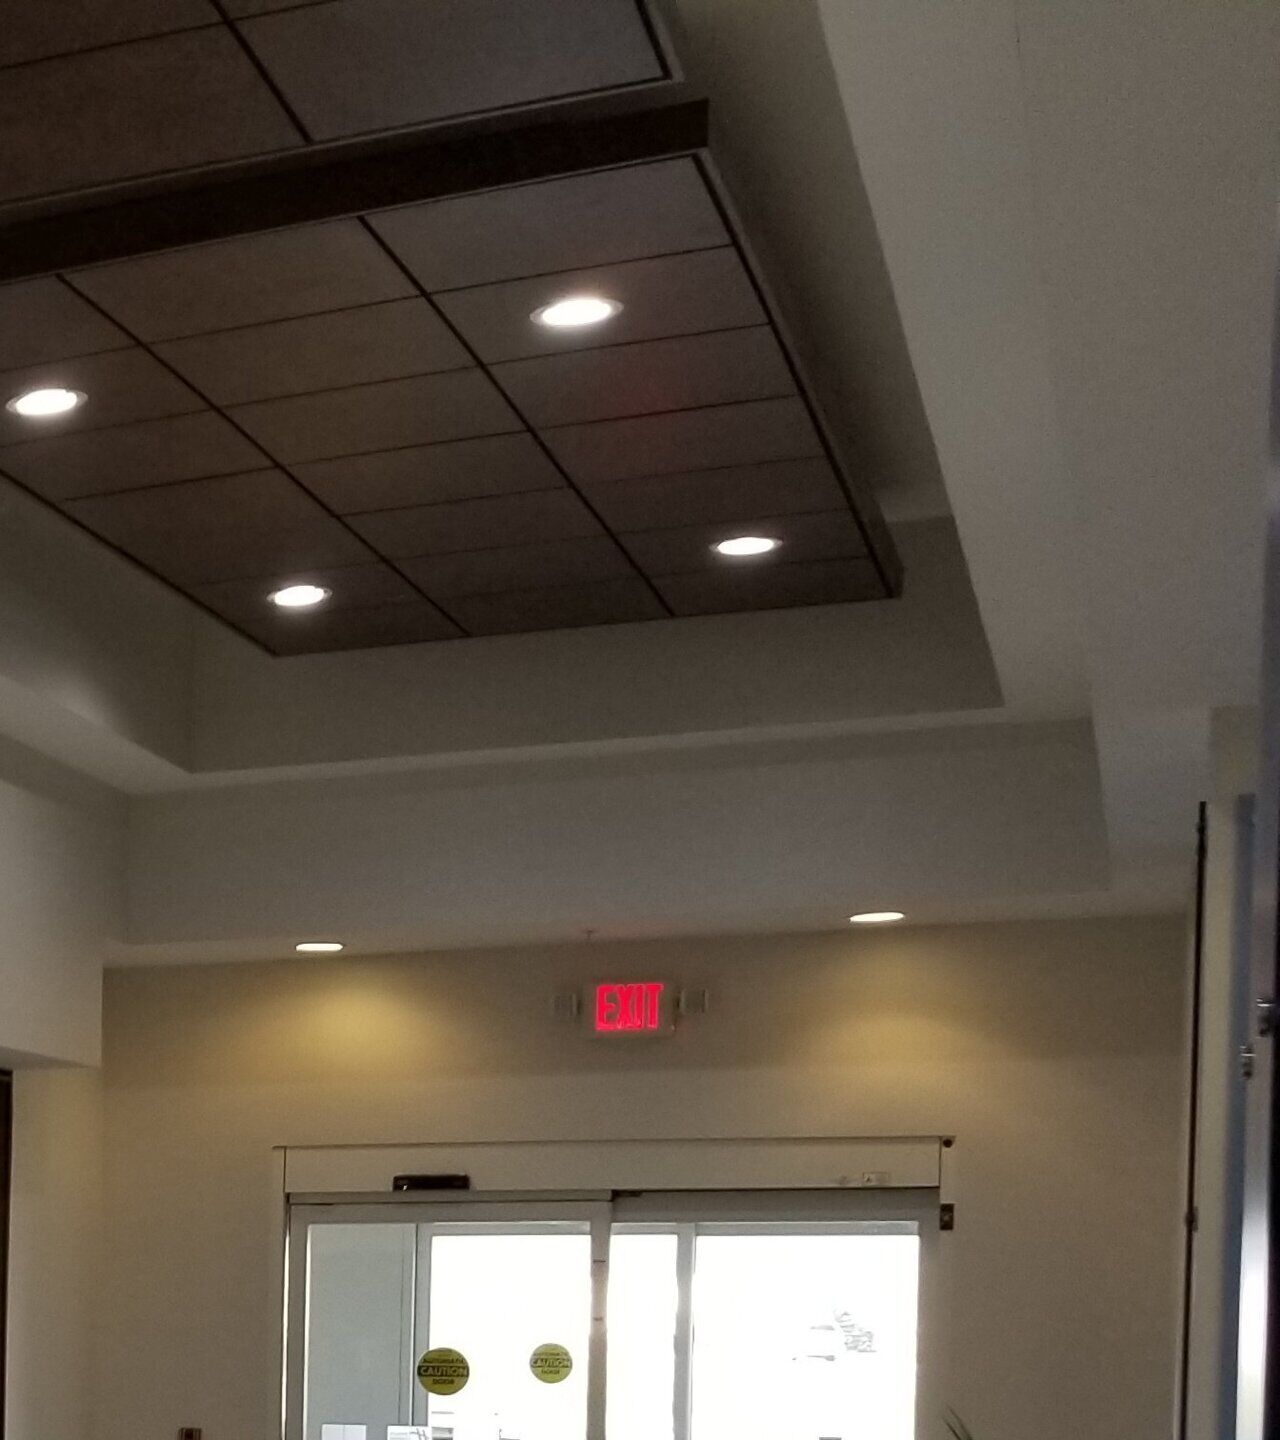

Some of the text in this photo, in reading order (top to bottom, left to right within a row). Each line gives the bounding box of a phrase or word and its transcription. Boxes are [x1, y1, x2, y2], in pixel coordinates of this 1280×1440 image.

[596, 983, 664, 1030] EXIT
[532, 1358, 571, 1368] CAUTION
[420, 1366, 467, 1376] CAUTION
